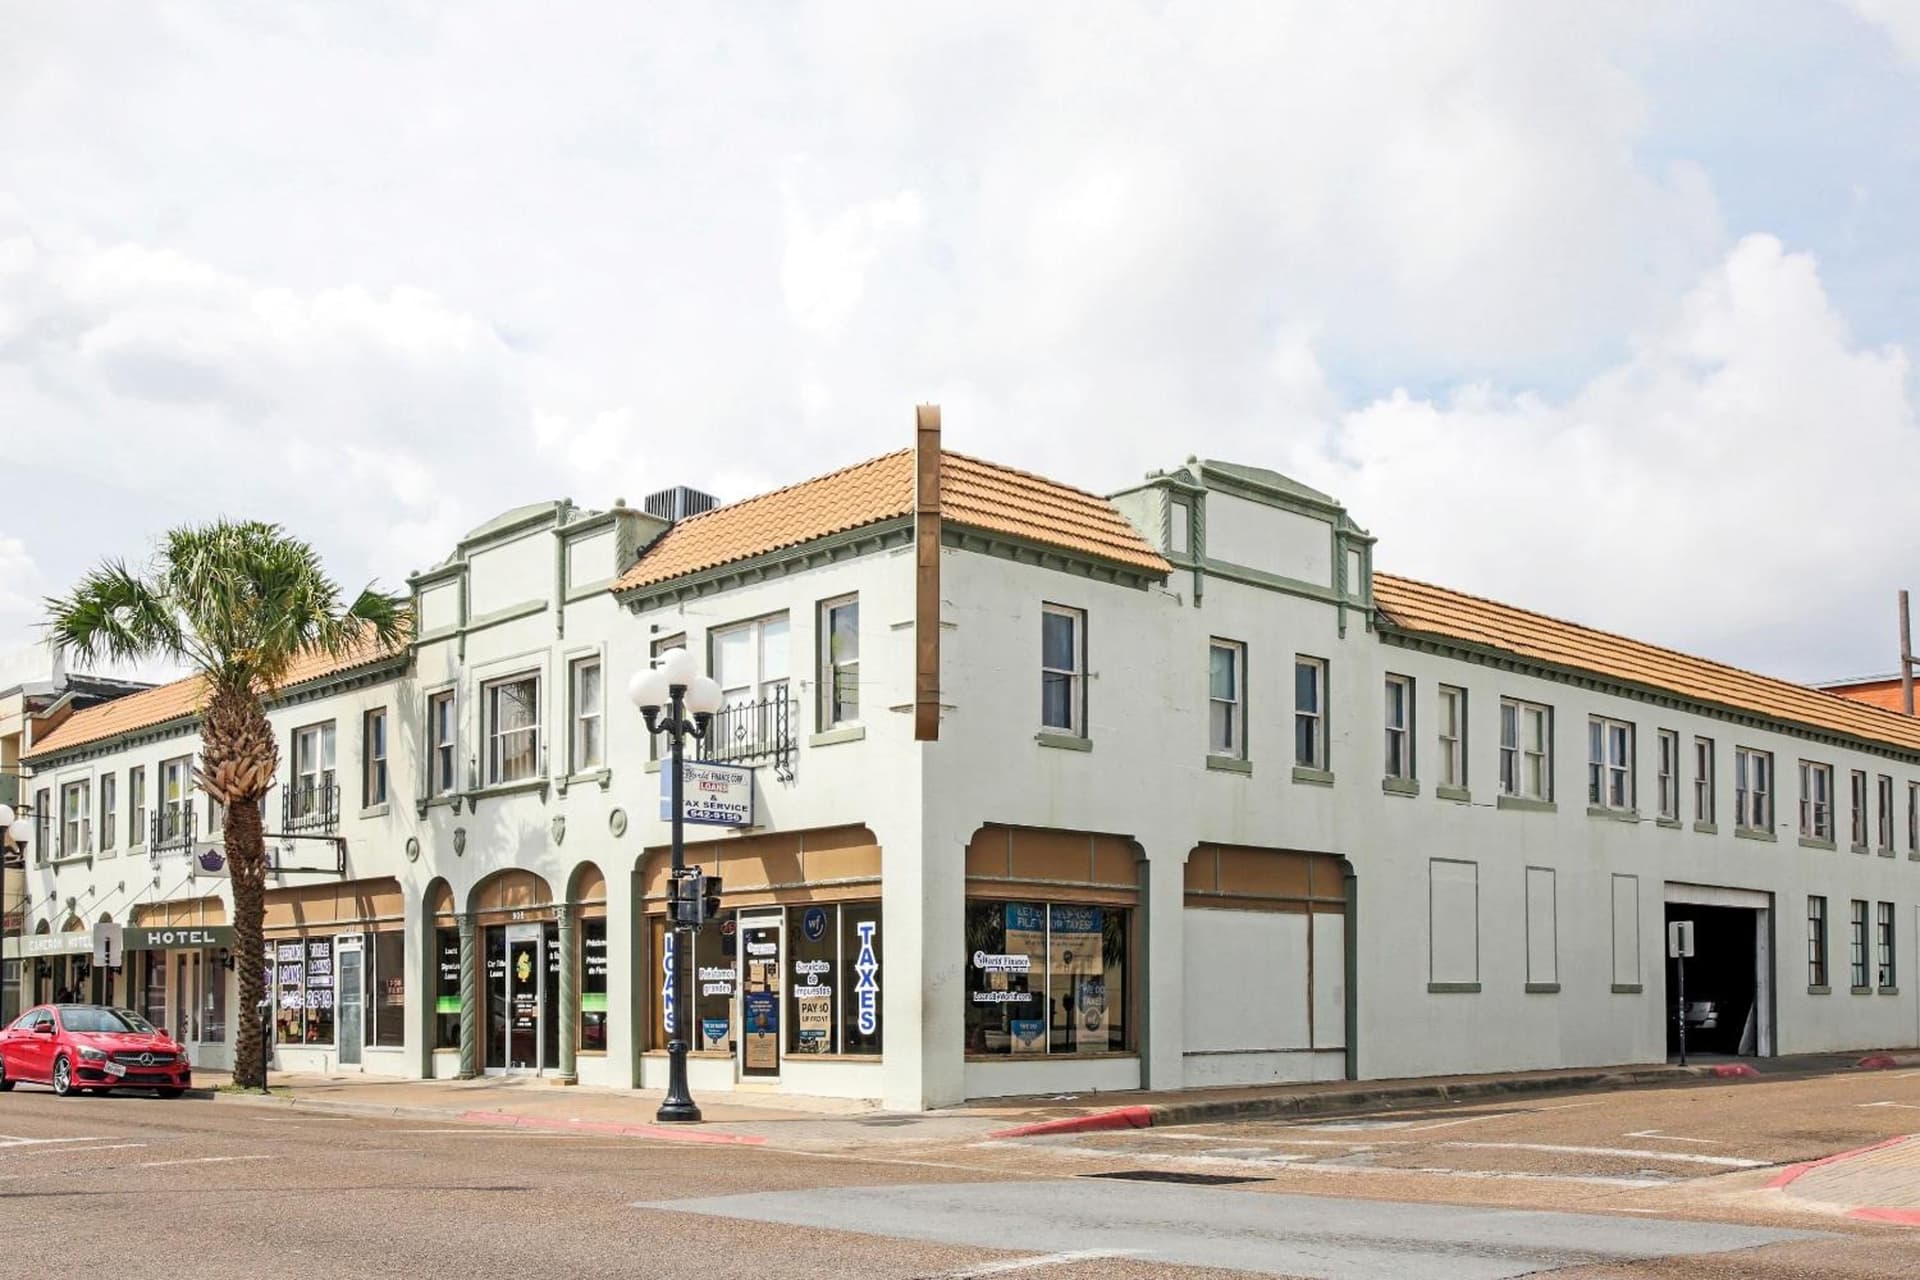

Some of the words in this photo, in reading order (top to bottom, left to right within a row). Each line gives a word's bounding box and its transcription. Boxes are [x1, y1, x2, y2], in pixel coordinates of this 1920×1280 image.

[700, 781, 729, 793] LOANS
[684, 800, 700, 808] AX
[703, 802, 749, 813] SERVICE
[148, 931, 216, 945] HOTEL
[859, 926, 876, 1030] TAXES
[801, 1002, 817, 1013] PAY
